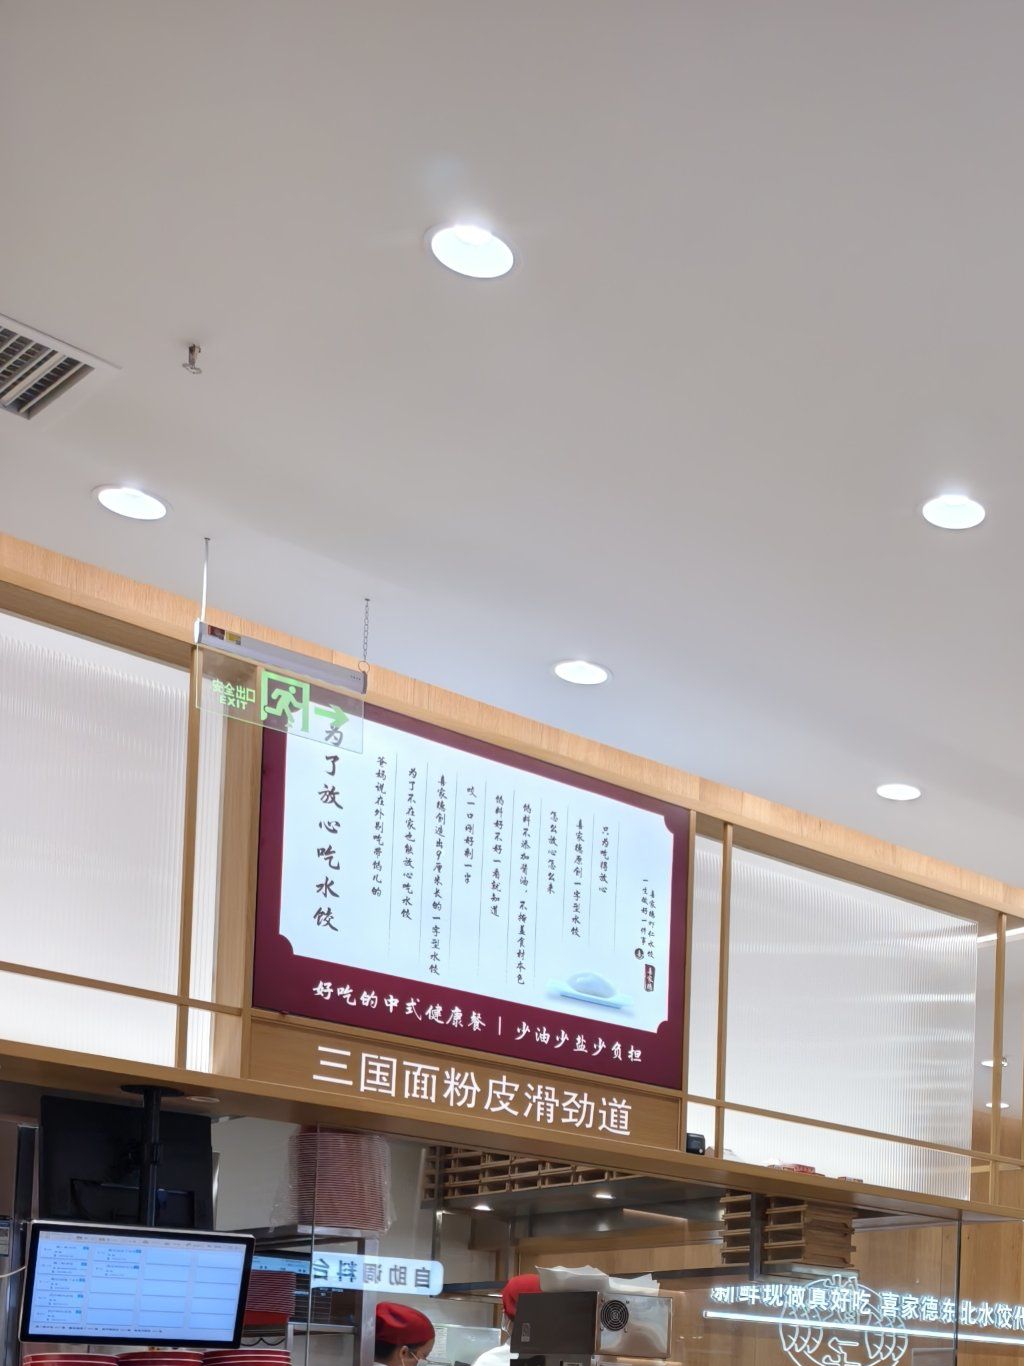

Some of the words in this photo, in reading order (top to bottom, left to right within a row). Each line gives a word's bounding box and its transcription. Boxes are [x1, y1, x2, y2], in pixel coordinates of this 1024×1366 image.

[212, 679, 256, 703] 安全出口
[219, 697, 248, 710] EXIT
[313, 722, 344, 932] 为了放心吃水饺
[312, 980, 487, 1032] 好吃的中式健康餐
[514, 1021, 642, 1063] 少油少盐少负担
[312, 1045, 633, 1137] 三国面粉皮滑劲道
[710, 1284, 872, 1315] 新鲜现做真好吃
